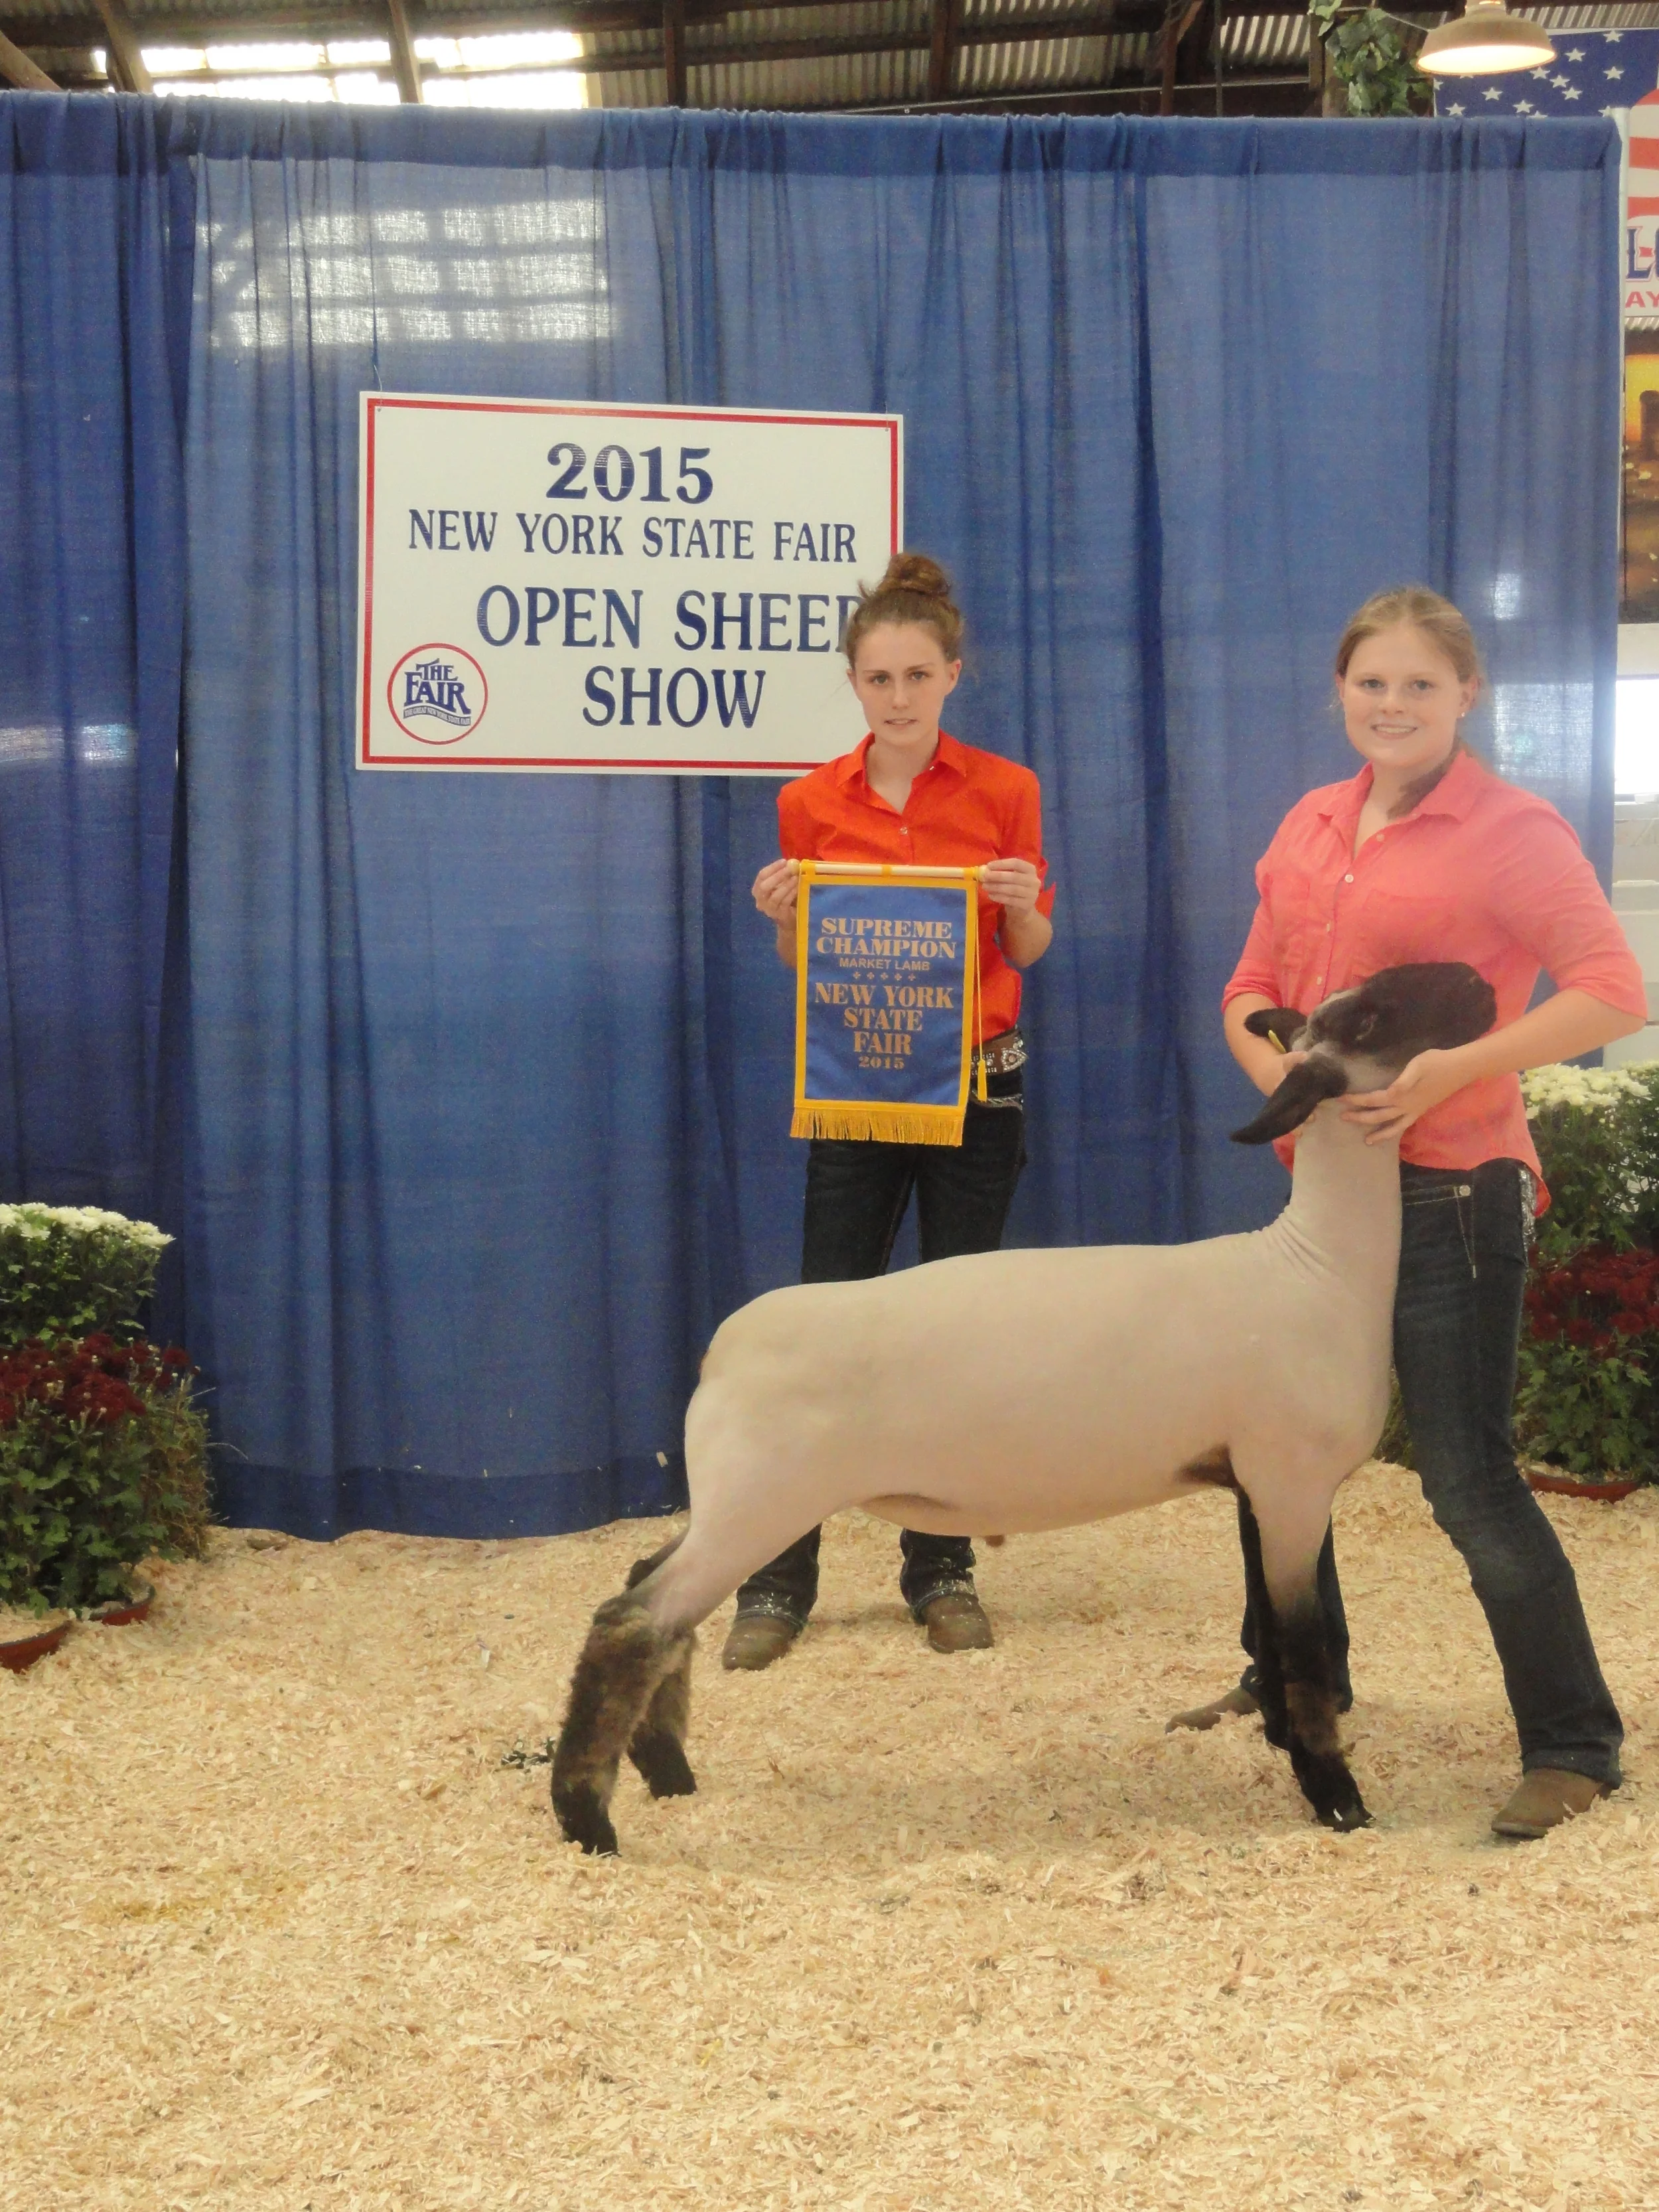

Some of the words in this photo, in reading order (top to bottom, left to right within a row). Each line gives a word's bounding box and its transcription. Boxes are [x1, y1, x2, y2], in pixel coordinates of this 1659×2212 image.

[547, 442, 713, 504] 2015
[409, 508, 498, 552] NEW
[516, 512, 624, 555] YORK
[642, 516, 754, 559] STATE
[774, 521, 857, 563] FAIR
[476, 585, 643, 649] OPEN
[416, 658, 458, 681] THE
[404, 672, 471, 715] FAIR
[583, 665, 766, 729] SHOW
[821, 917, 952, 939] SUPREME
[816, 936, 956, 959] CHAMPION
[839, 957, 891, 970] MARKET
[895, 960, 930, 971] LAMB
[815, 982, 876, 1005] NEW
[883, 986, 954, 1009] YORK
[843, 1007, 923, 1031] STATE
[853, 1031, 912, 1055] FAIR
[859, 1056, 905, 1070] 2015
